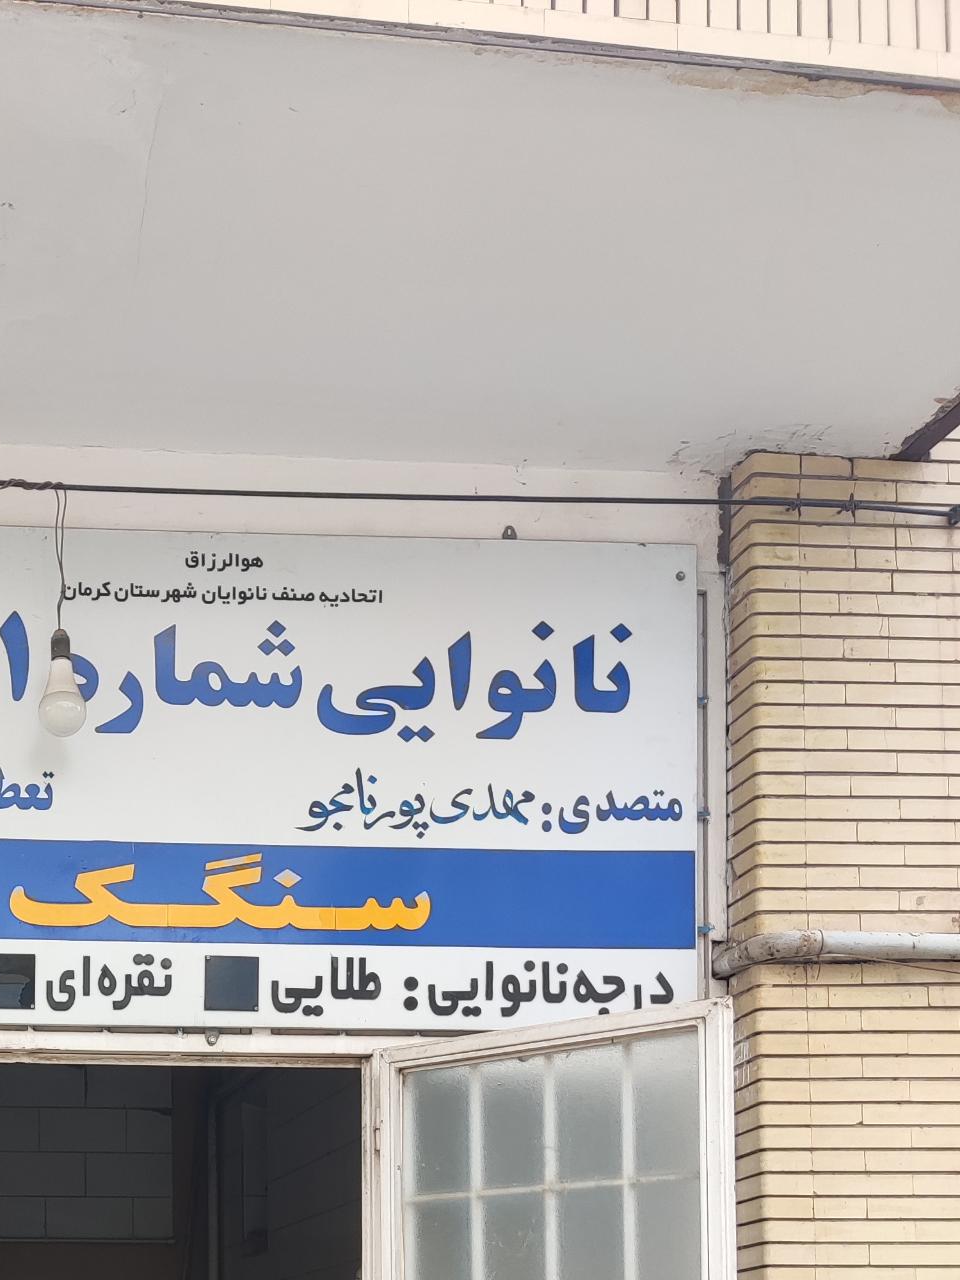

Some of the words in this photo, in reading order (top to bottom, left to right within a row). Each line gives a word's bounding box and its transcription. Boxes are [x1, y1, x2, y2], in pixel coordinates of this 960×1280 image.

[185, 551, 264, 572] هوالرزاق
[62, 581, 111, 601] کرمان
[201, 585, 268, 605] نانوایان
[271, 587, 316, 603] صنف
[67, 619, 303, 734] شماره
[316, 619, 633, 743] نانوایی
[429, 782, 537, 826] مهدی
[9, 853, 432, 932] سنگک
[271, 953, 383, 1017] طلایی
[573, 970, 675, 1016] درجه
